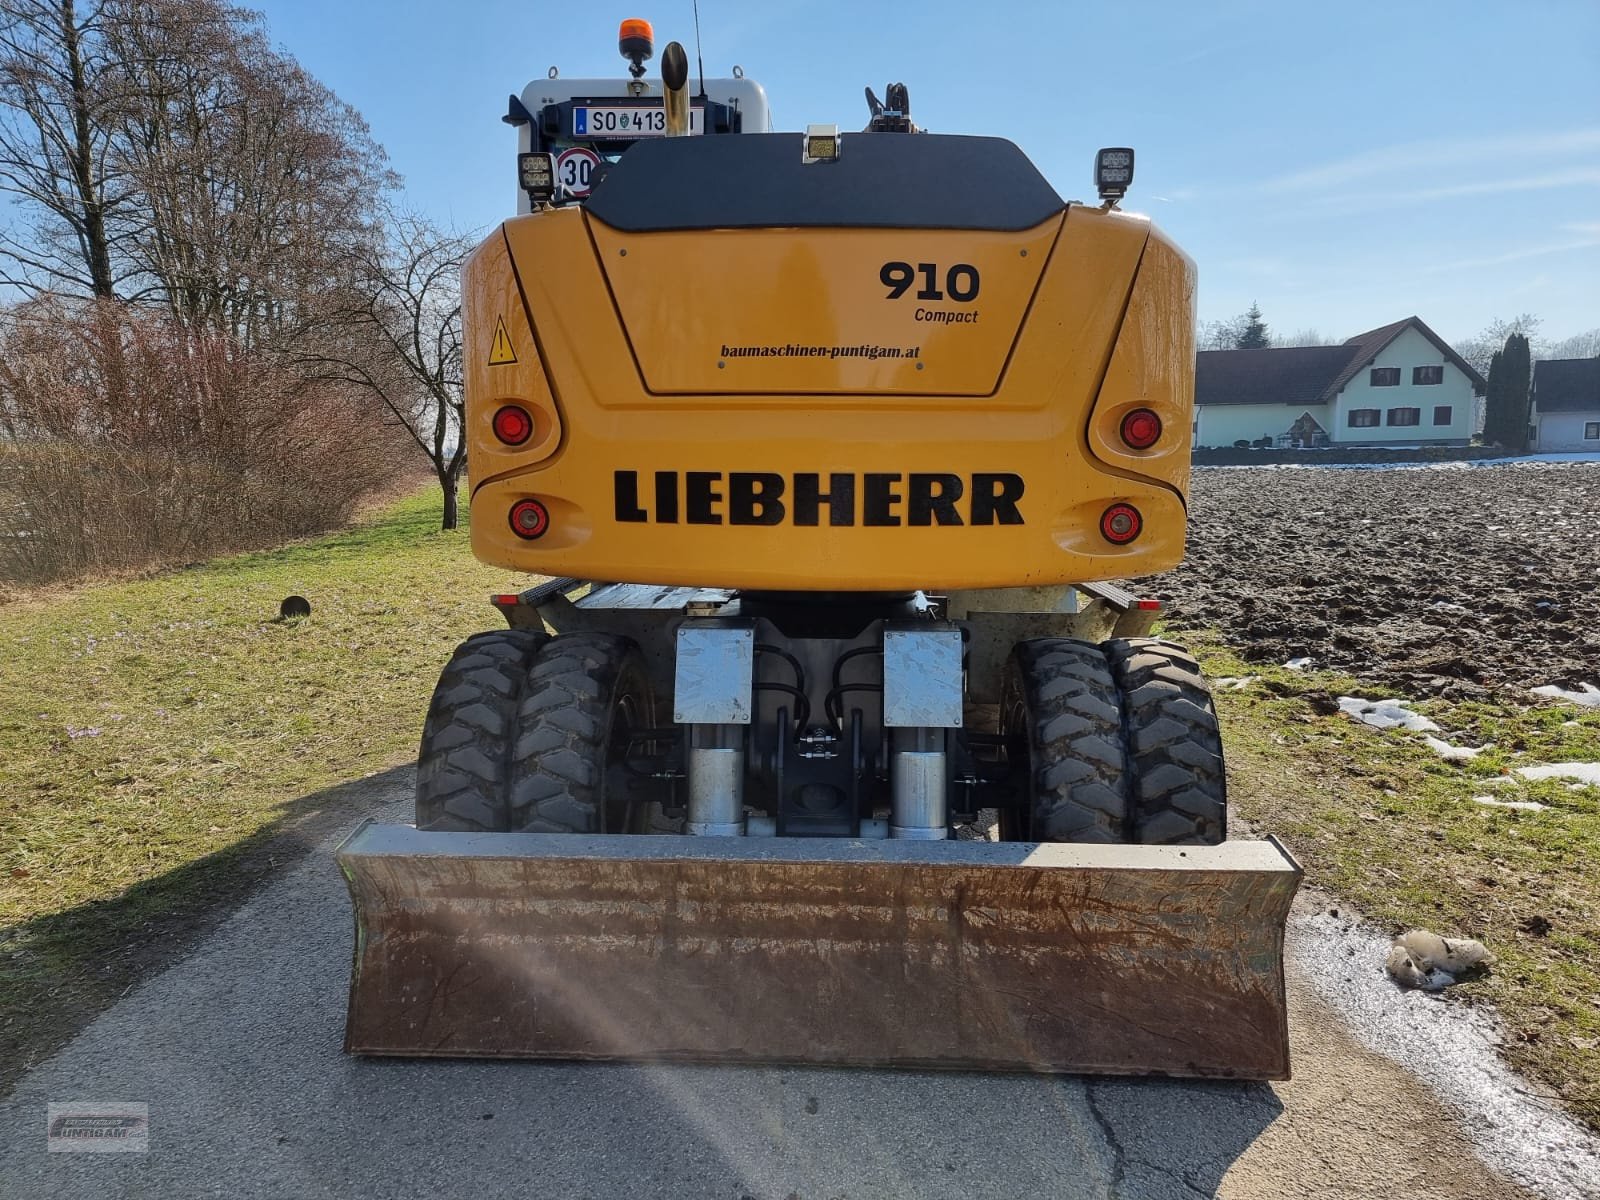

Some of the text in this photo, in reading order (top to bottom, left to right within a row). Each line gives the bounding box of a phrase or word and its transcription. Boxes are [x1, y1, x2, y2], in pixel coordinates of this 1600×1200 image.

[593, 111, 616, 131] SO
[564, 159, 592, 186] 30
[879, 261, 980, 302] 910
[914, 308, 979, 325] Compact
[720, 344, 920, 360] baumaschinen-puntigam.at
[614, 470, 1025, 526] LIEBHERR
